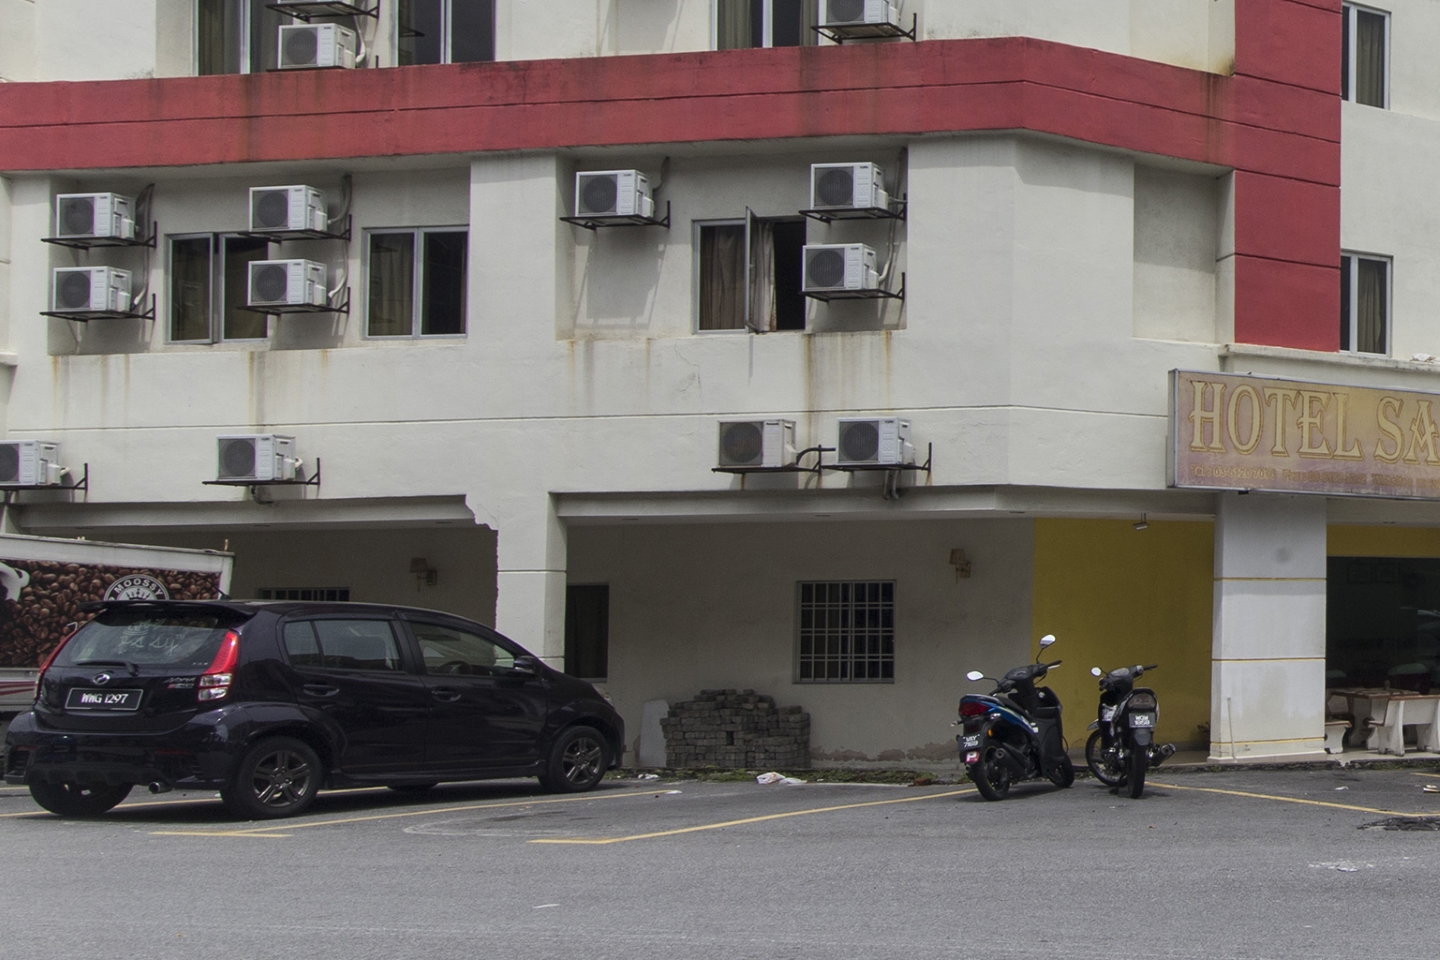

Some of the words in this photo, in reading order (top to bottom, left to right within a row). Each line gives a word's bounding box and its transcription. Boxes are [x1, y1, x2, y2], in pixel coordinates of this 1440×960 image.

[1189, 380, 1364, 461] HOTEL
[114, 578, 164, 596] MOOSSY
[104, 693, 129, 704] 1297
[966, 751, 977, 761] P
